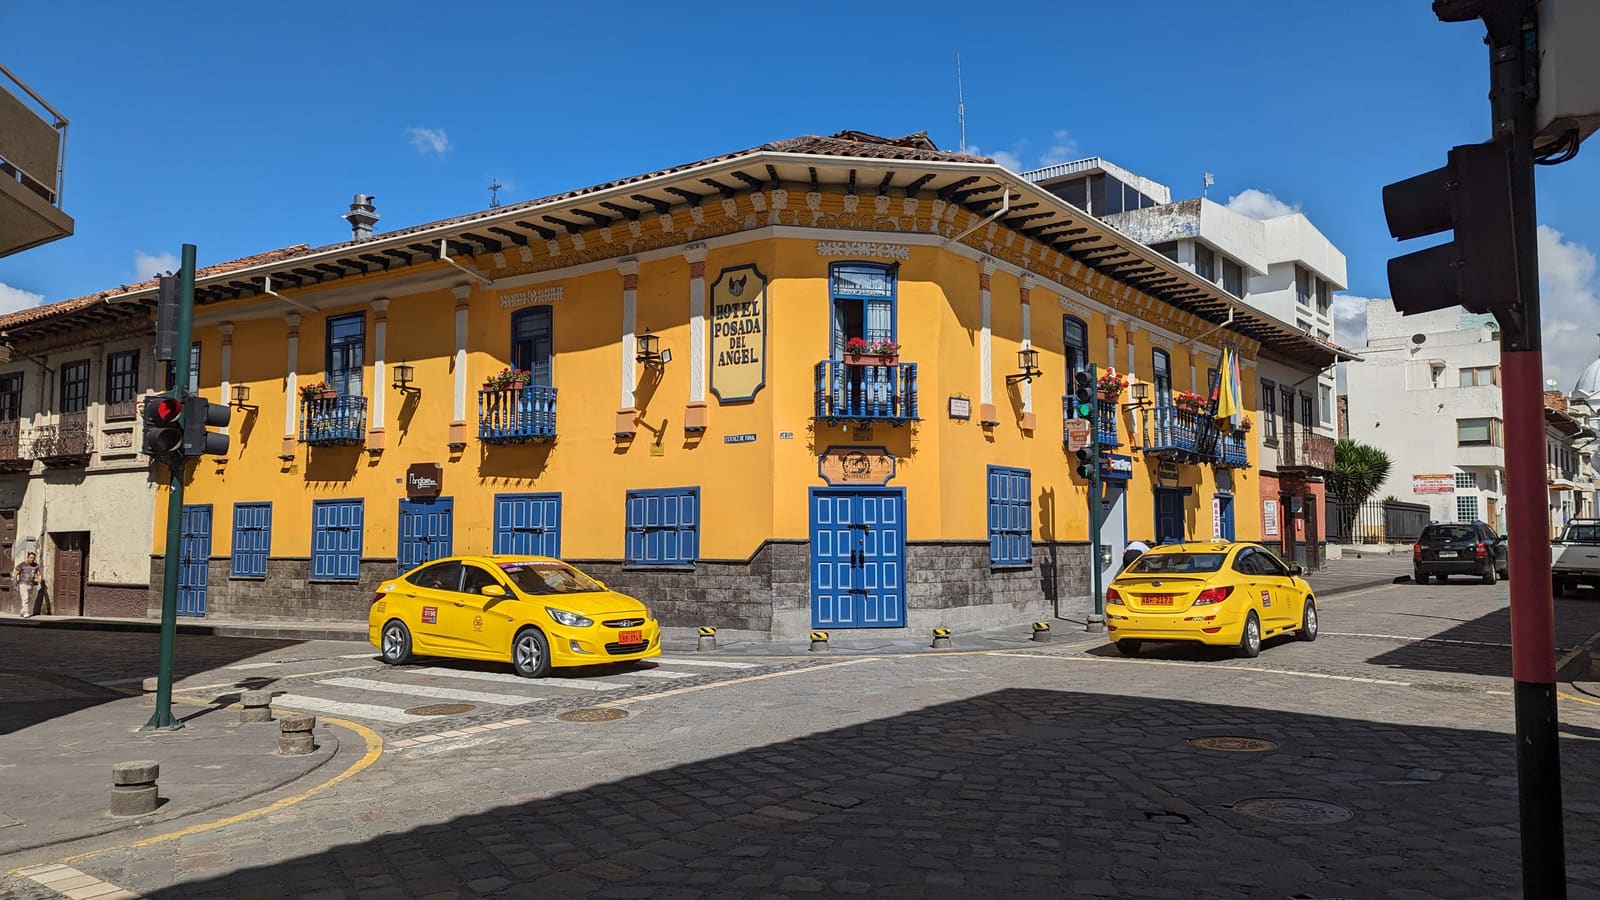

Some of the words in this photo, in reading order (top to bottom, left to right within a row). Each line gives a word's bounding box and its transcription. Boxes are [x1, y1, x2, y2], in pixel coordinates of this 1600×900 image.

[716, 301, 760, 320] HOTEL
[714, 318, 761, 338] POSADA
[729, 336, 746, 349] DEL
[718, 348, 759, 367] ANGEL
